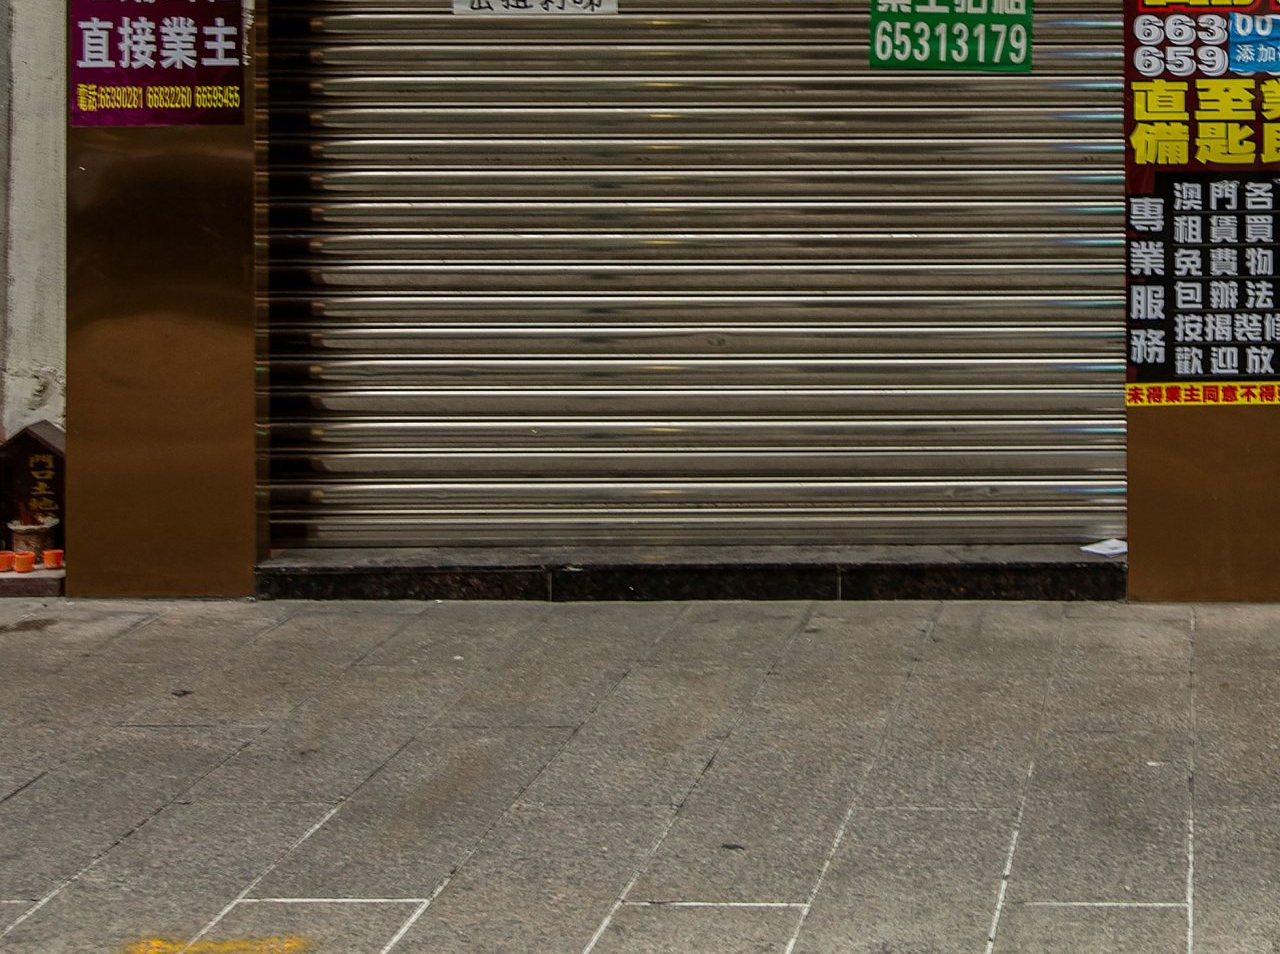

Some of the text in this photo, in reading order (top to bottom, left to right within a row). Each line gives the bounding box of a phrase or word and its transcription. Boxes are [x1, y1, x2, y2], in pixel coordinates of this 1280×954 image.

[77, 16, 240, 69] 直接業主
[874, 20, 1027, 64] 65313179
[1129, 197, 1166, 364] 專業服務
